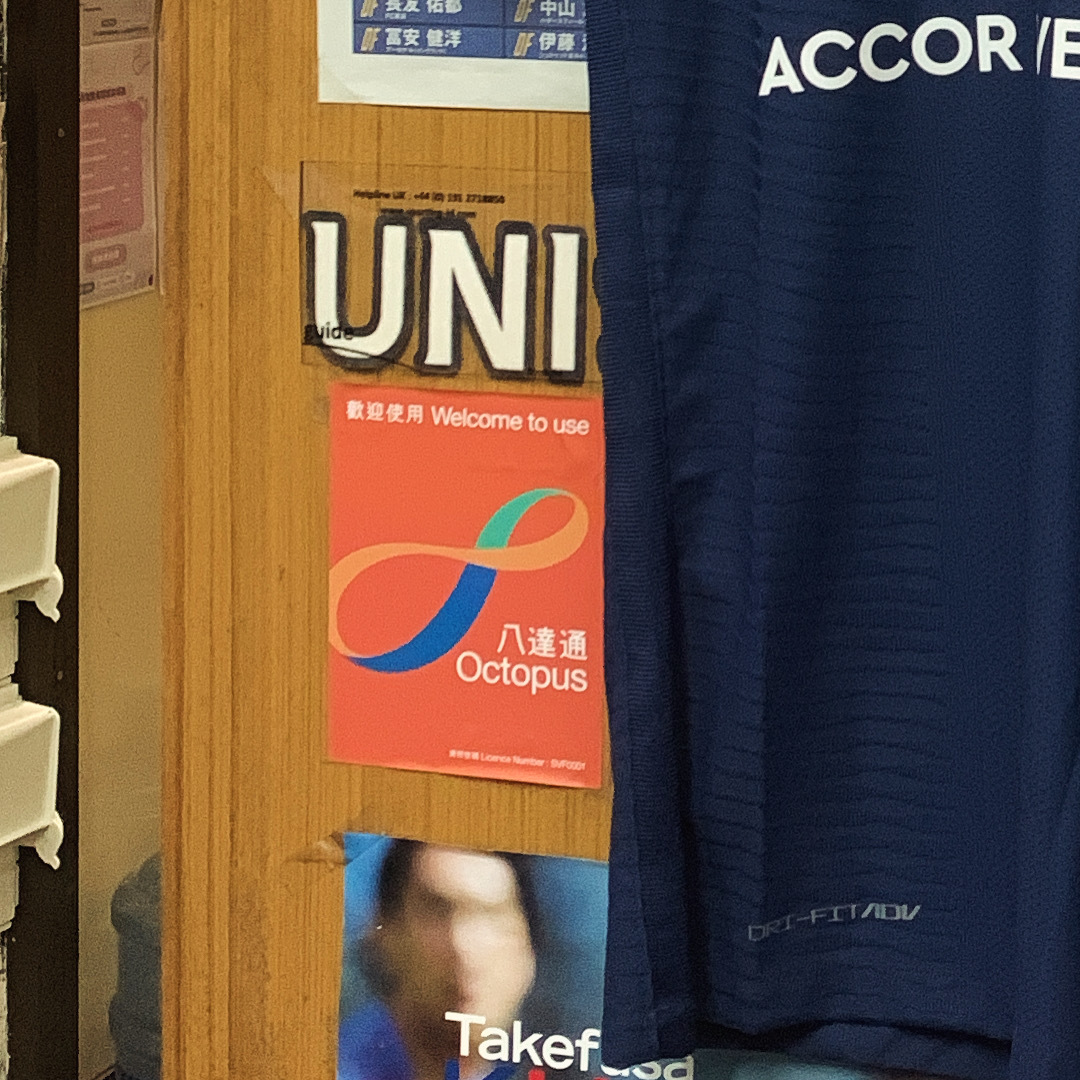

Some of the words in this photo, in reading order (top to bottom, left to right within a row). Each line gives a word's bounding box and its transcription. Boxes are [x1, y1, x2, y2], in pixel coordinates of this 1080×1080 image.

[758, 14, 1023, 97] ACCOR
[304, 213, 586, 383] UNI
[431, 405, 523, 431] Welcome
[528, 413, 548, 432] to
[553, 418, 590, 436] use
[497, 623, 588, 661] 八達通
[456, 651, 588, 695] Octopus
